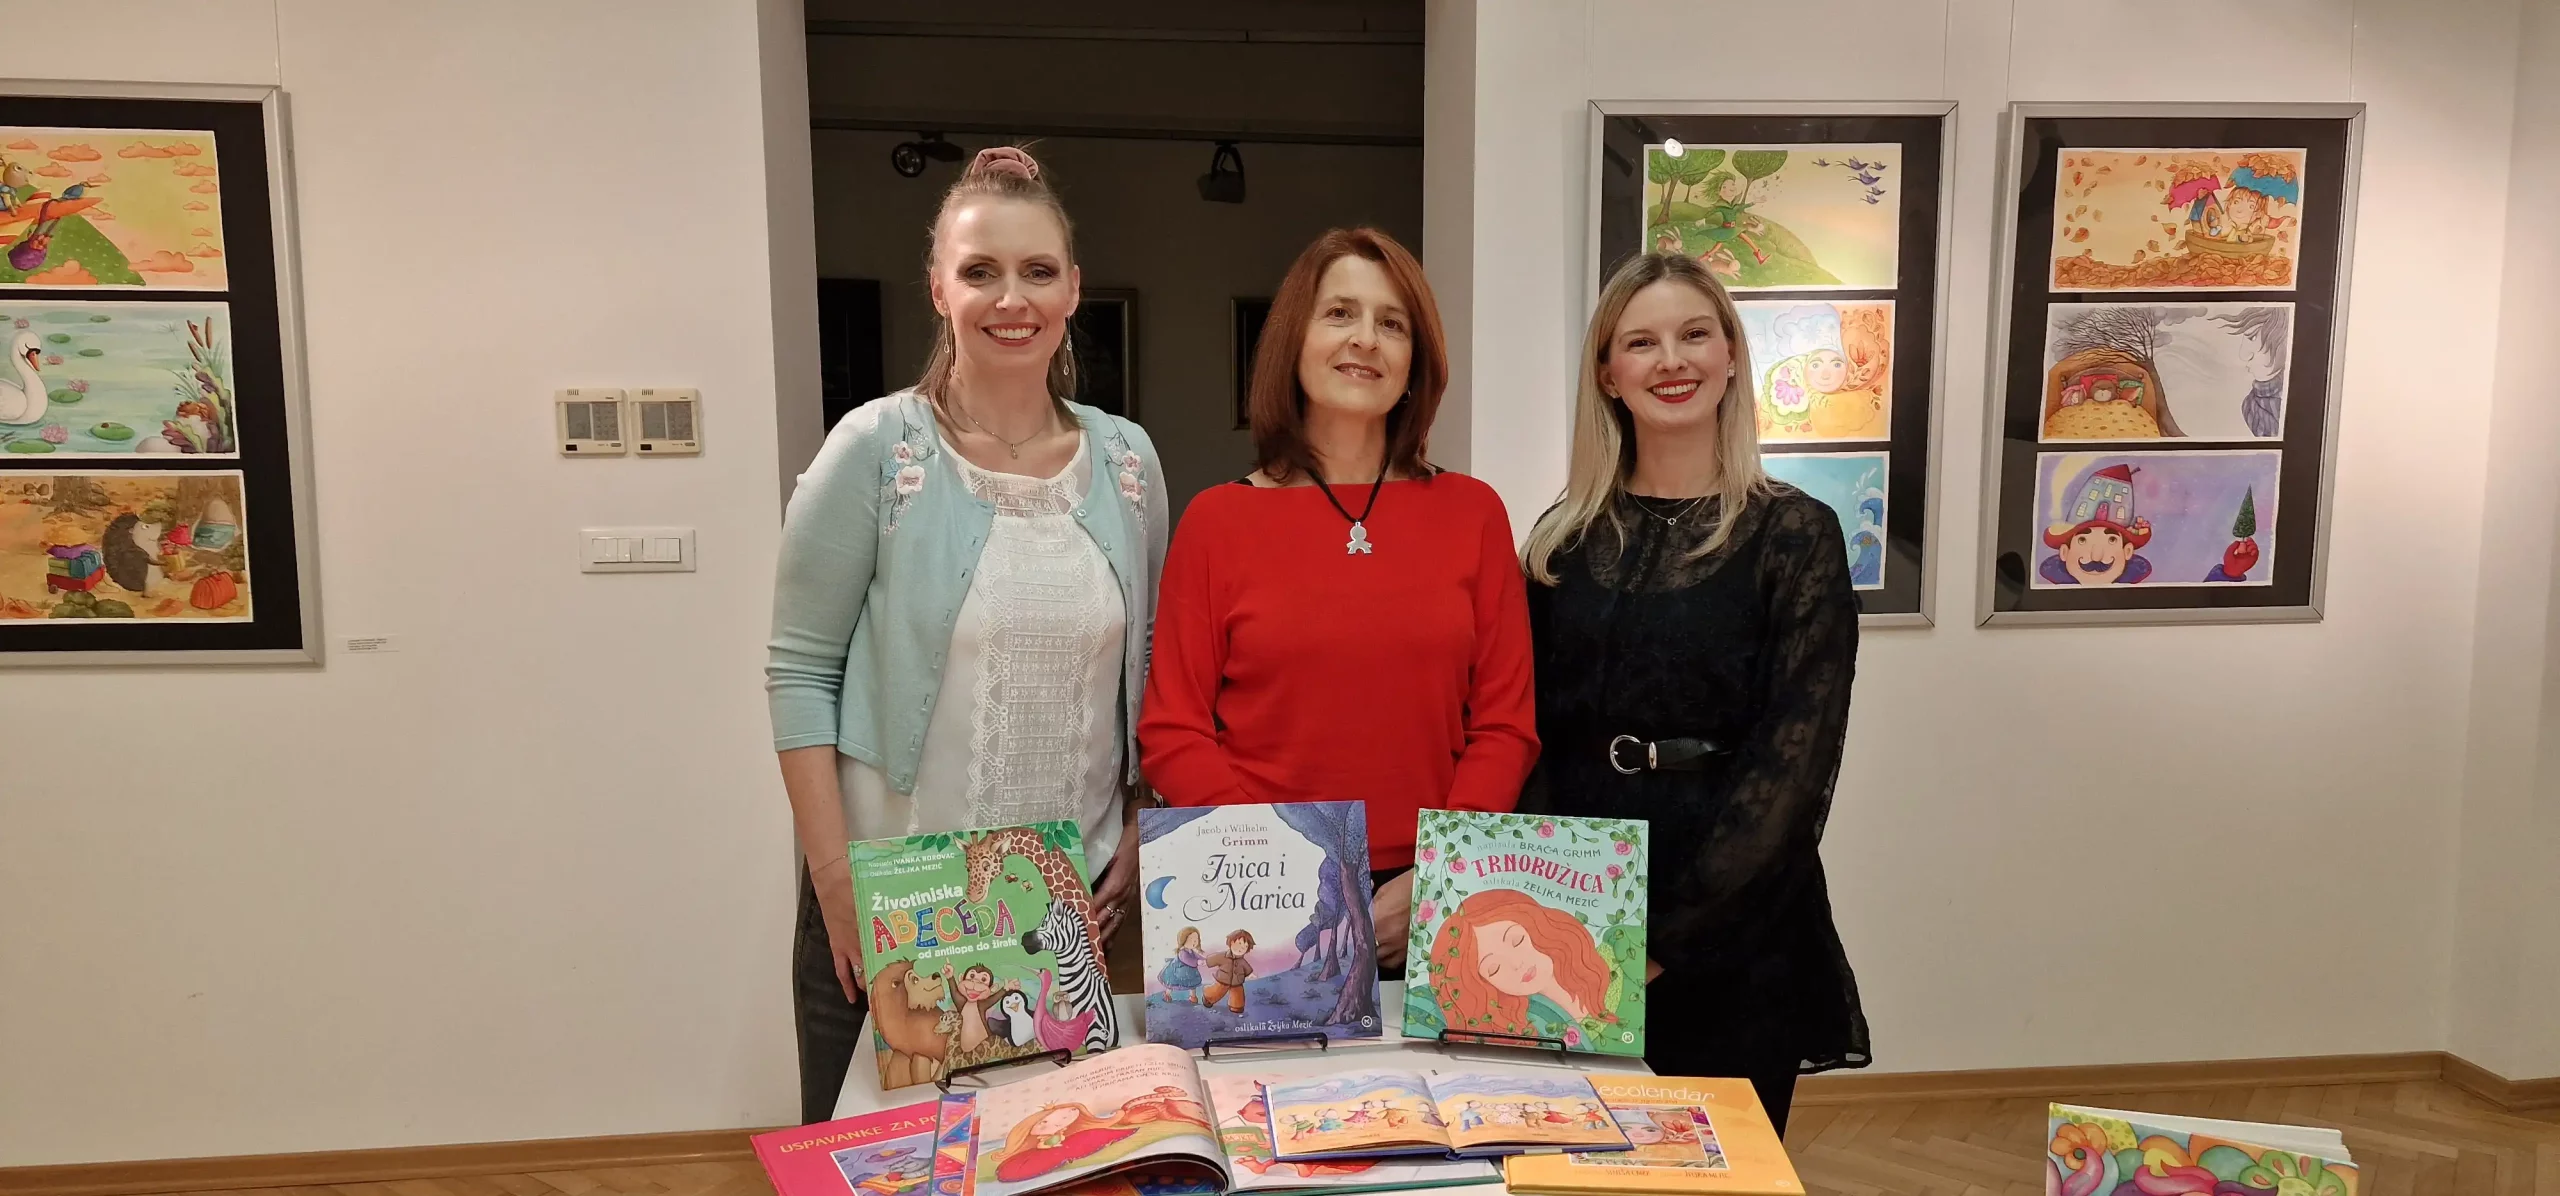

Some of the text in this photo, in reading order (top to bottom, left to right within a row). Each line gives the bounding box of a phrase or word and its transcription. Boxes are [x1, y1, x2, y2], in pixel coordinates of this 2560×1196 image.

[1196, 826, 1221, 837] Jacob
[1229, 823, 1268, 833] Wilhelm
[1222, 836, 1268, 847] Grimm
[893, 855, 920, 864] IVANKA
[1563, 848, 1601, 859] GRIMM
[894, 865, 920, 875] ŽELJKA
[1201, 853, 1286, 888] Ivica i
[1471, 853, 1606, 894] TRNORUŽICA
[871, 883, 964, 911] Životinjska
[1183, 880, 1305, 922] Marica
[1523, 880, 1562, 901] ŽELJKA
[1565, 895, 1600, 908] MEZIĆ
[871, 898, 1016, 954] ABECEDA
[918, 937, 1018, 959] od antilope do žirafe
[1599, 1085, 1715, 1102] ecolendar
[780, 1126, 884, 1153] USPAVANKE
[890, 1121, 915, 1132] ZA
